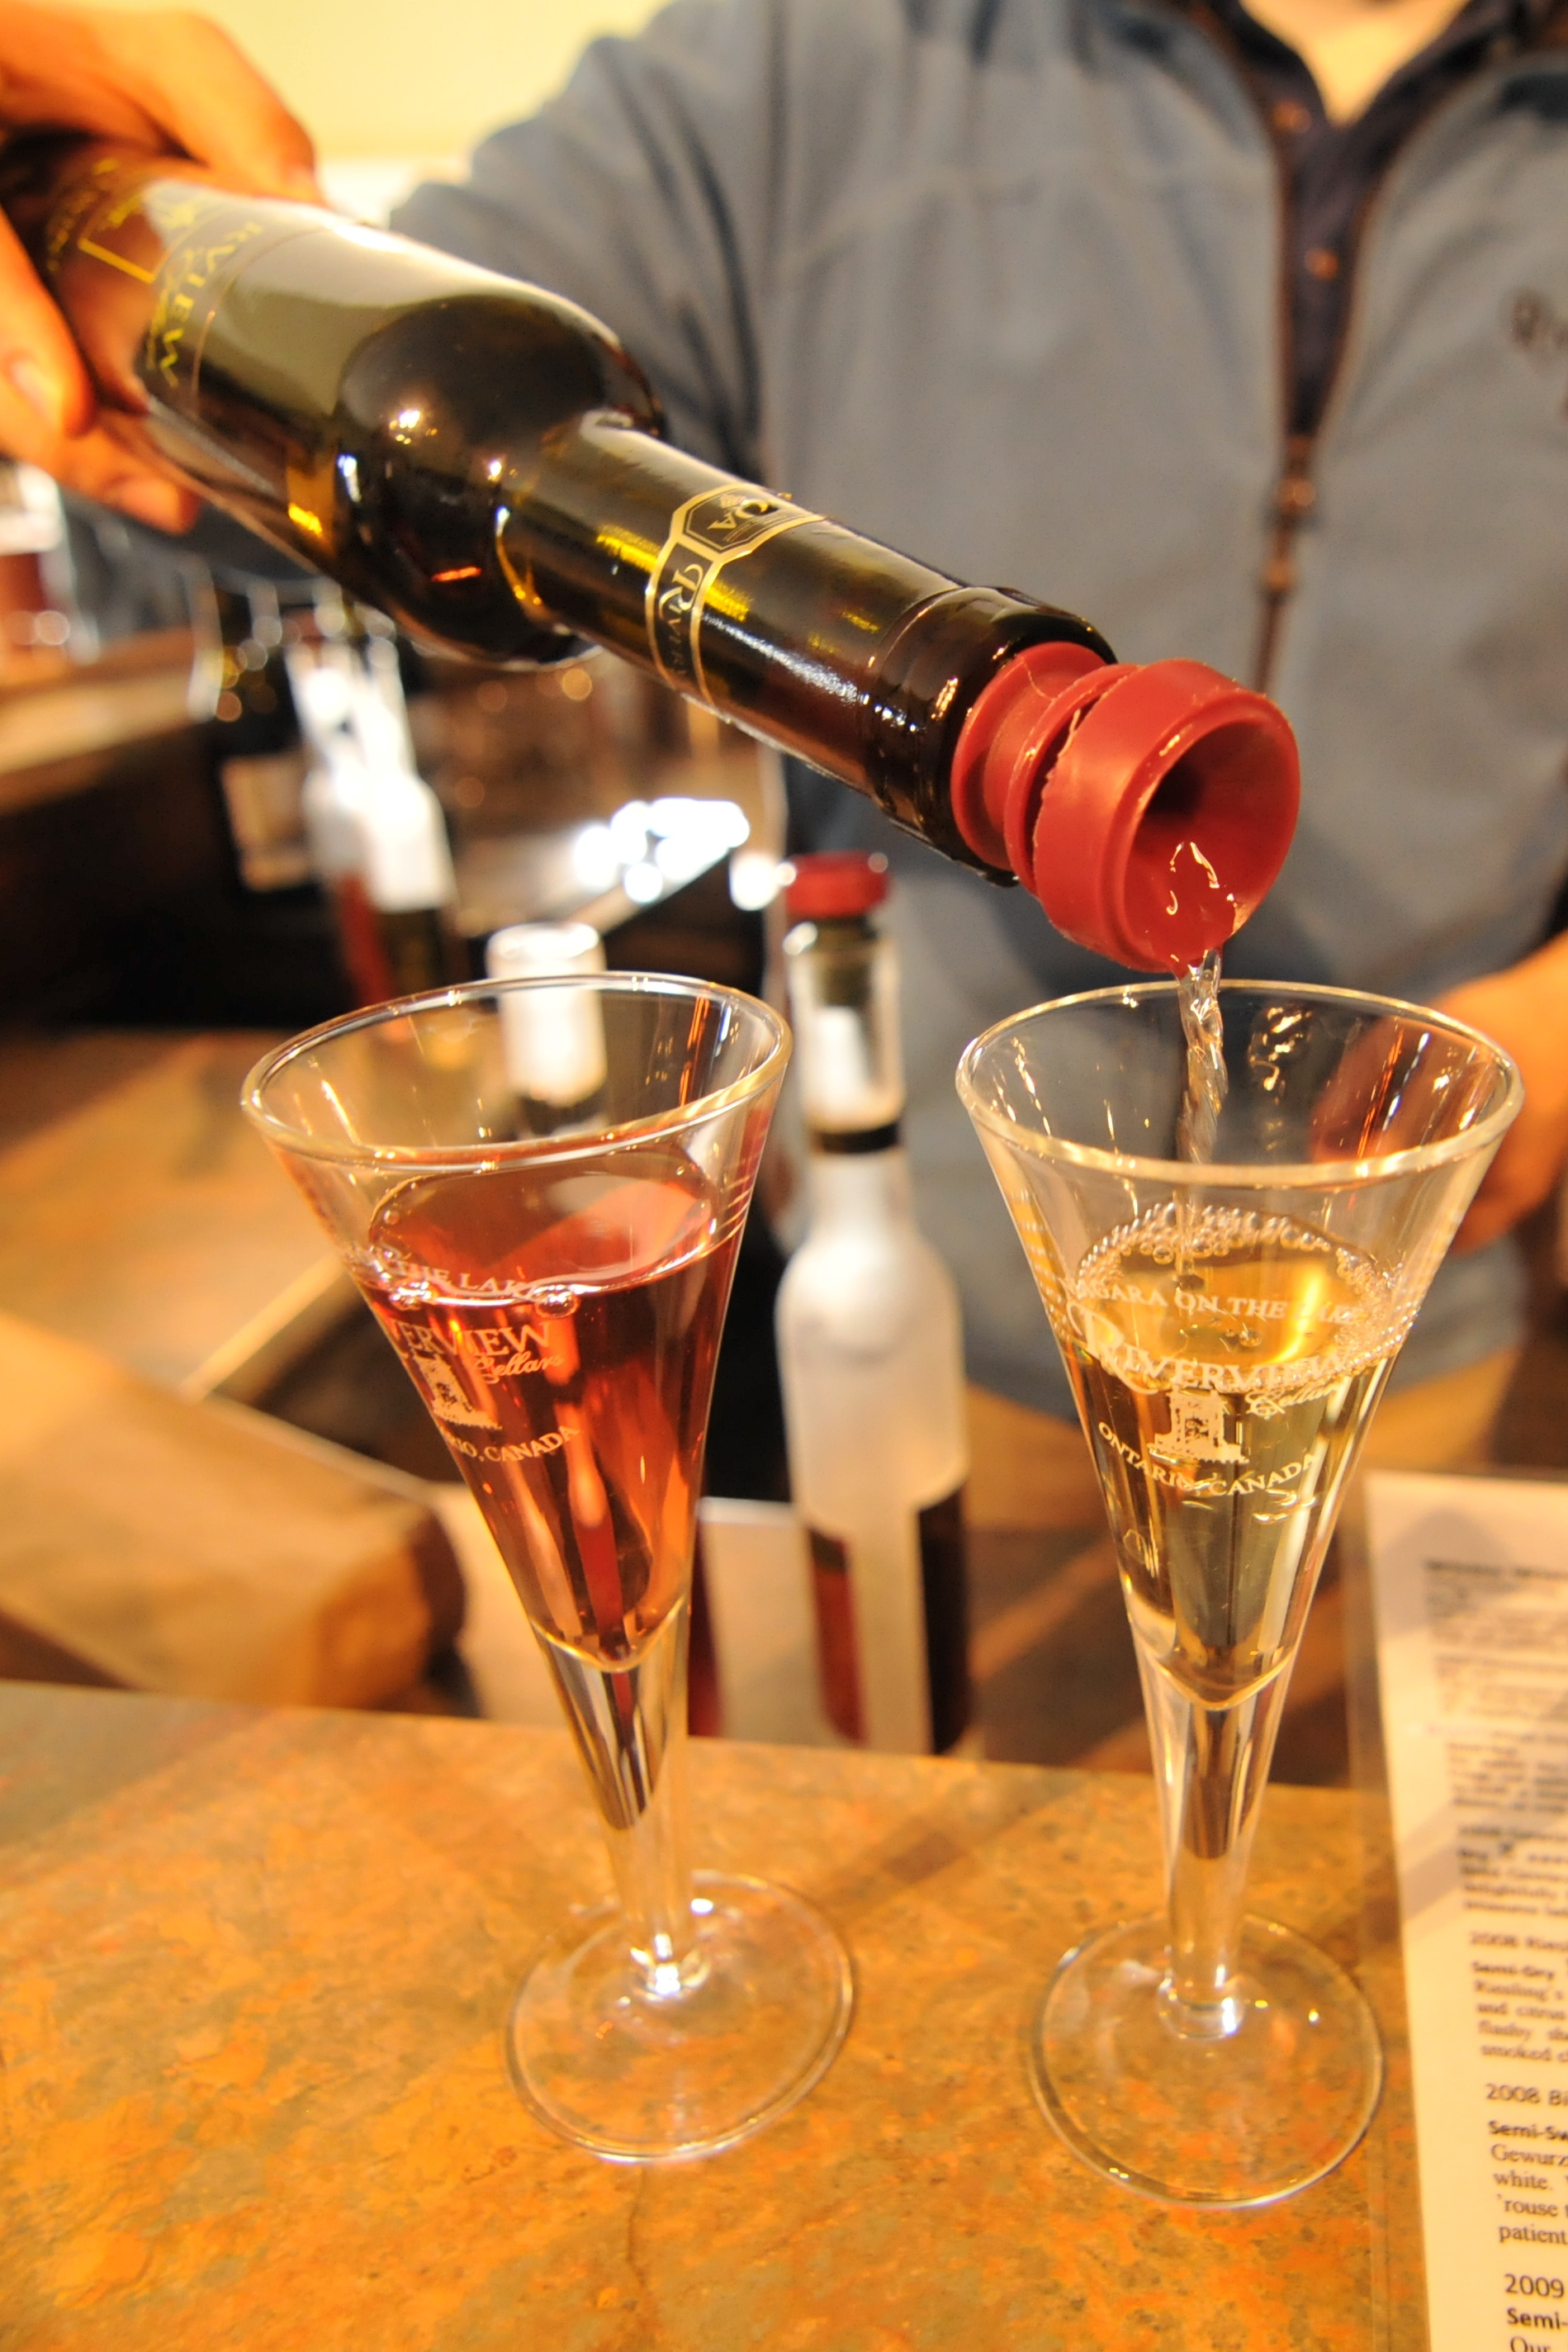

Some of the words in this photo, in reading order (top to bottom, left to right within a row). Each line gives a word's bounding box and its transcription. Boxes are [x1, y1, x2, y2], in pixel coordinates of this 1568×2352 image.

[1176, 1292, 1220, 1314] ON
[1229, 1297, 1288, 1319] THE
[398, 1321, 552, 1359] ERVIEW
[473, 1350, 563, 1385] Cellars
[484, 1425, 580, 1462] CANADA
[1208, 1453, 1321, 1496] CANADA
[1476, 2001, 1508, 2016] and
[1485, 2083, 1542, 2104] 2008
[1504, 2273, 1564, 2298] 2009
[1507, 2307, 1568, 2330] Semi-
